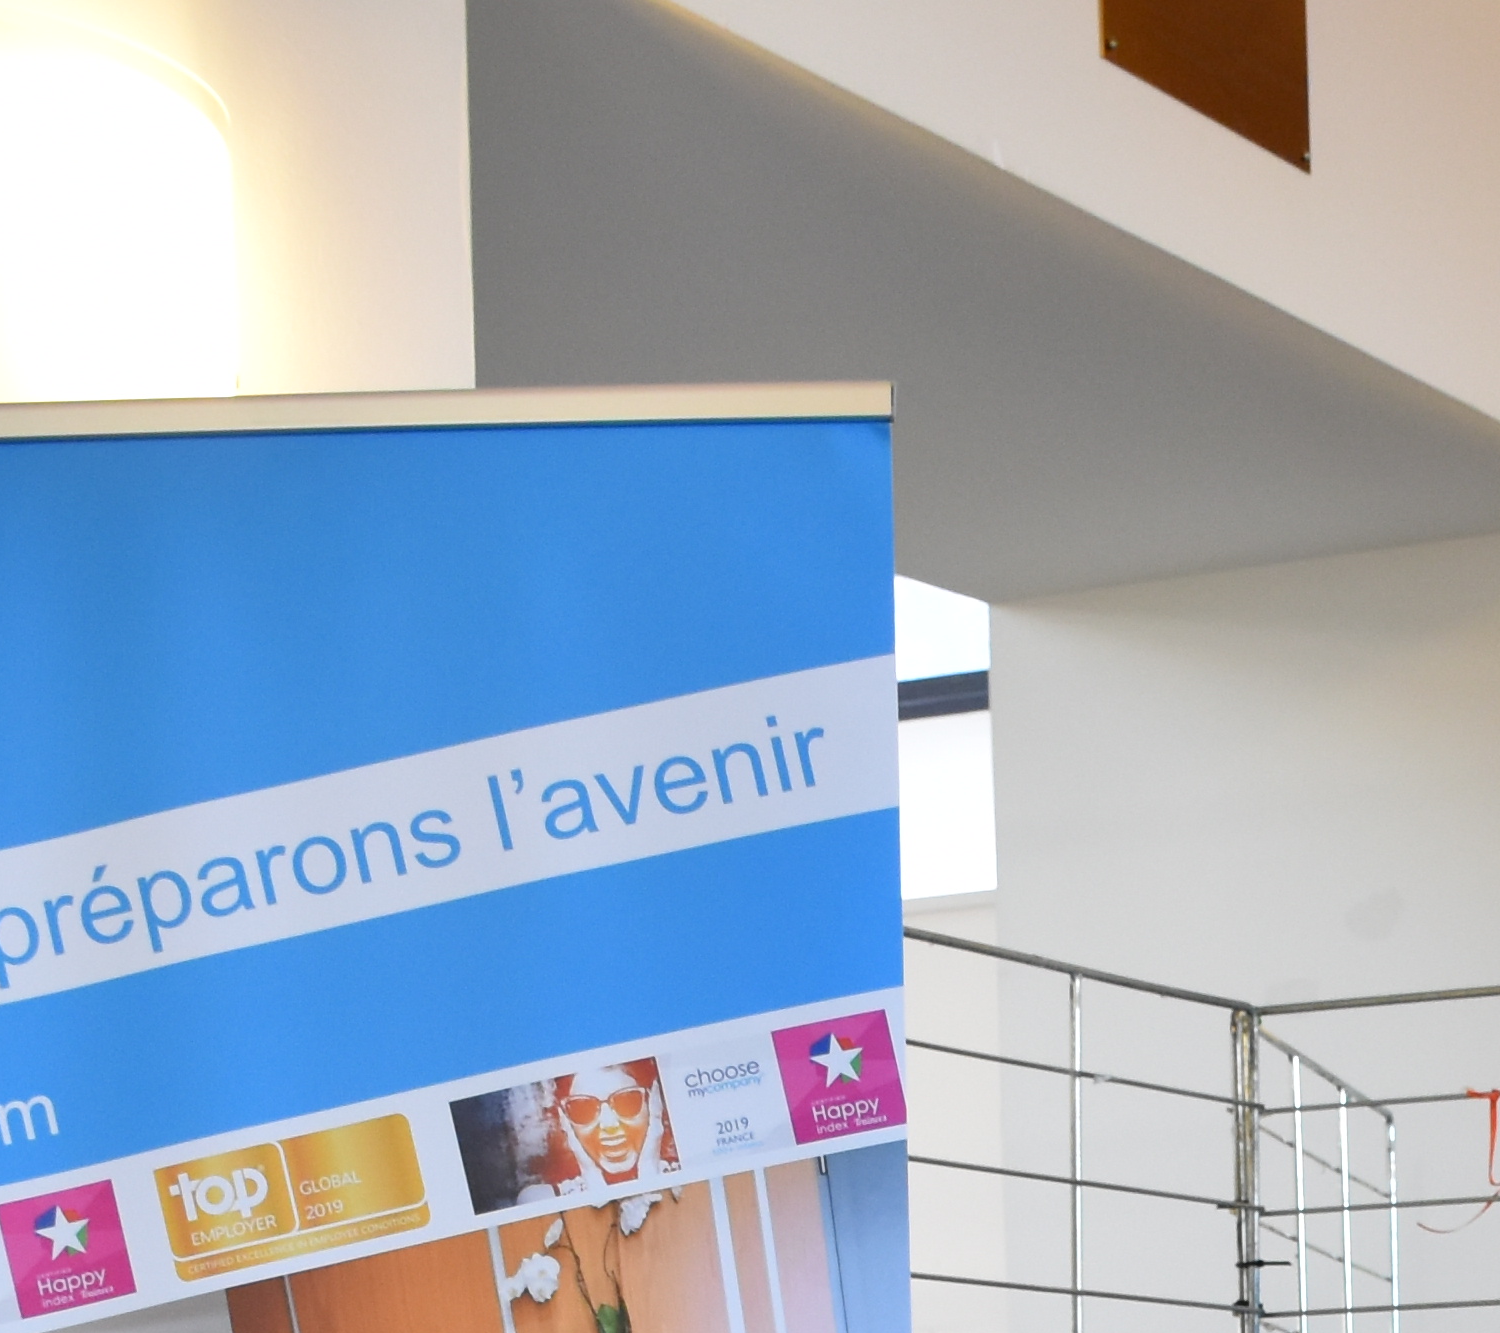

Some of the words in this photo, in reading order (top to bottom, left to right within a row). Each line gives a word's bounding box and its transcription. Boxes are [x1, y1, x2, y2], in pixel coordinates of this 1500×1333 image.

[684, 1060, 760, 1088] choose
[811, 1097, 879, 1123] Happy
[715, 1116, 749, 1135] 2019
[716, 1131, 755, 1147] FRANCE
[168, 1167, 269, 1222] top
[299, 1170, 362, 1196] GLOBAL
[305, 1199, 344, 1220] 2019
[190, 1214, 278, 1246] EMPLOYER
[37, 1268, 106, 1297] Happy
